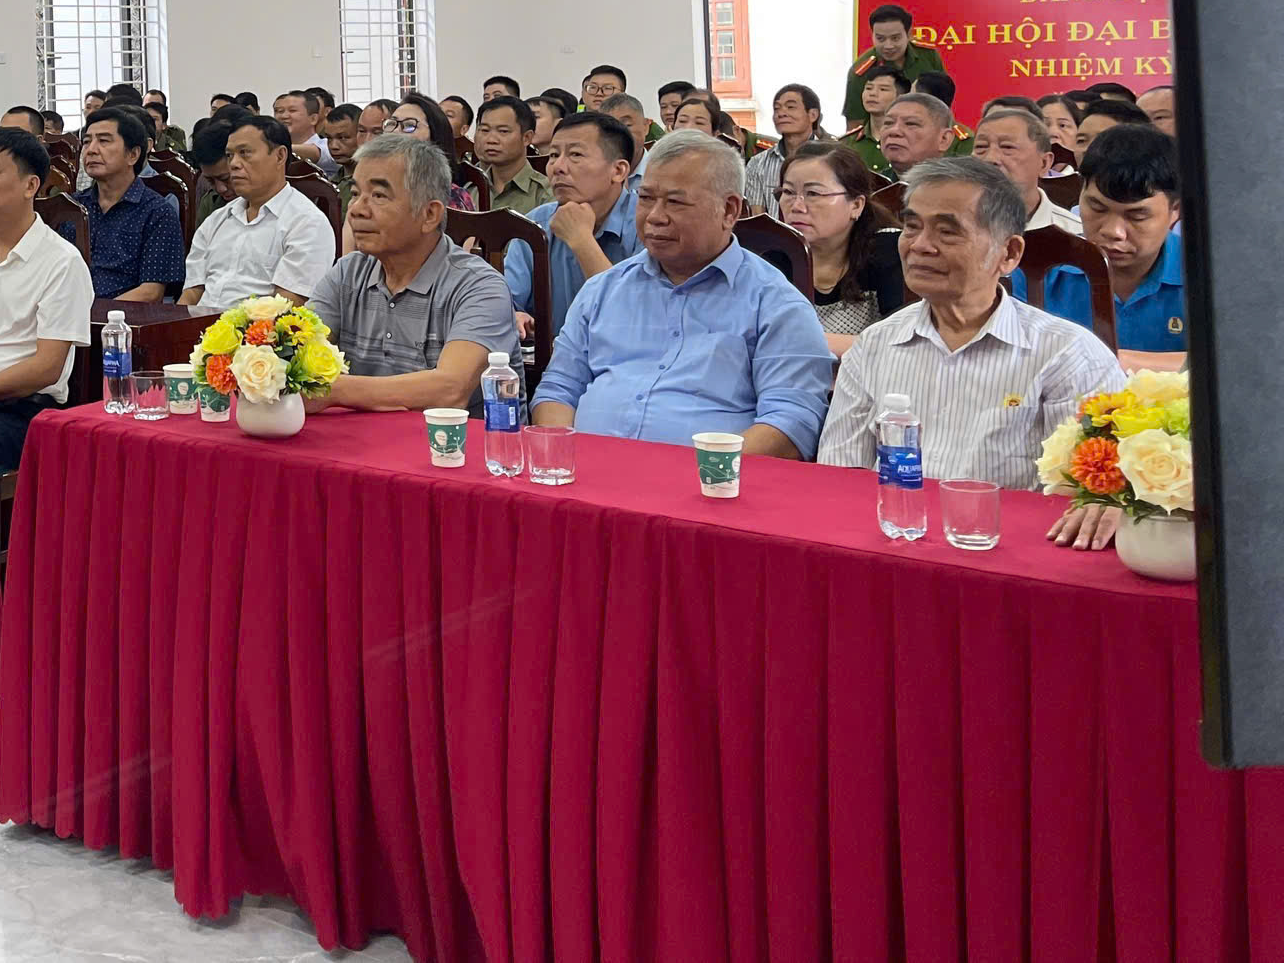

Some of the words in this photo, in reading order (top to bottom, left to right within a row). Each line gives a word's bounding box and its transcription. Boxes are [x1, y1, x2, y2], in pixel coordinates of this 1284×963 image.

[913, 24, 975, 50] ĐẠI
[988, 17, 1056, 48] HỘI
[1068, 20, 1137, 46] ĐẠI
[1010, 52, 1124, 81] NHIỆM
